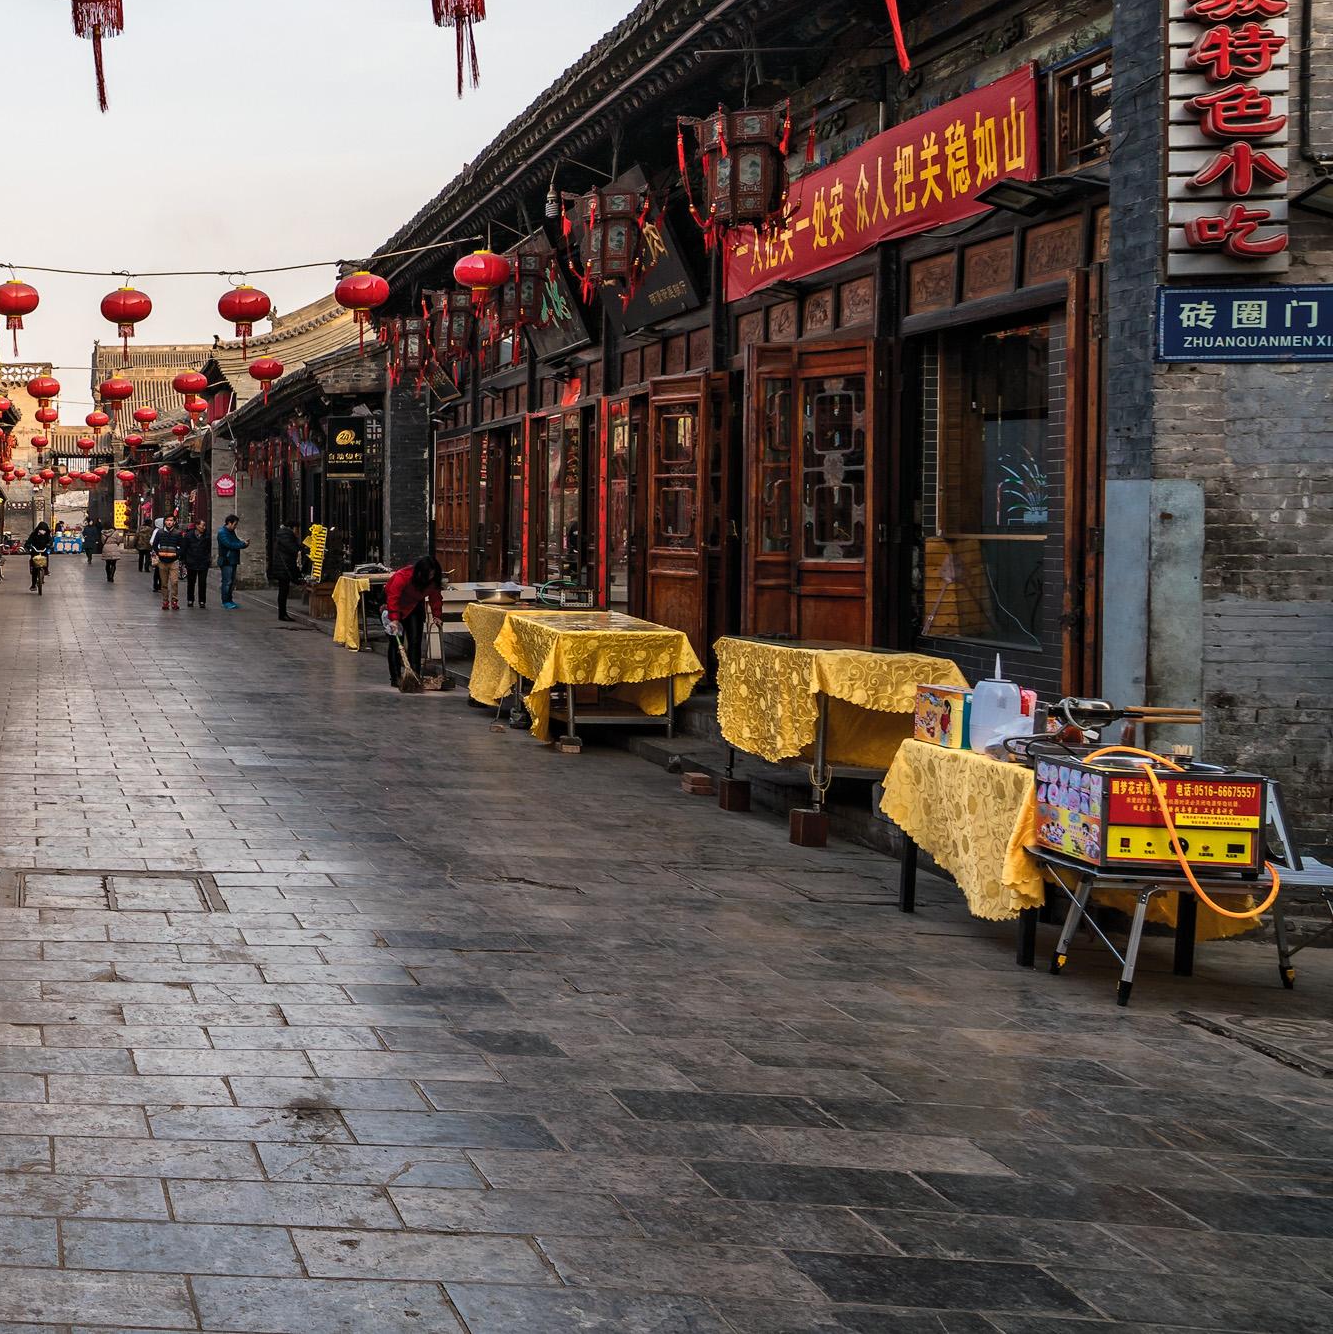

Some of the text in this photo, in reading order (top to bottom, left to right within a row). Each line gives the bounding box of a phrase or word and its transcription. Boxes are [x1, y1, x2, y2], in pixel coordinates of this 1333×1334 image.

[735, 96, 1026, 275] 一人把关一处安 众人把关稳如山
[1179, 300, 1318, 329] 砖圈门
[1183, 334, 1333, 348] ZHUANQUANMEN XI
